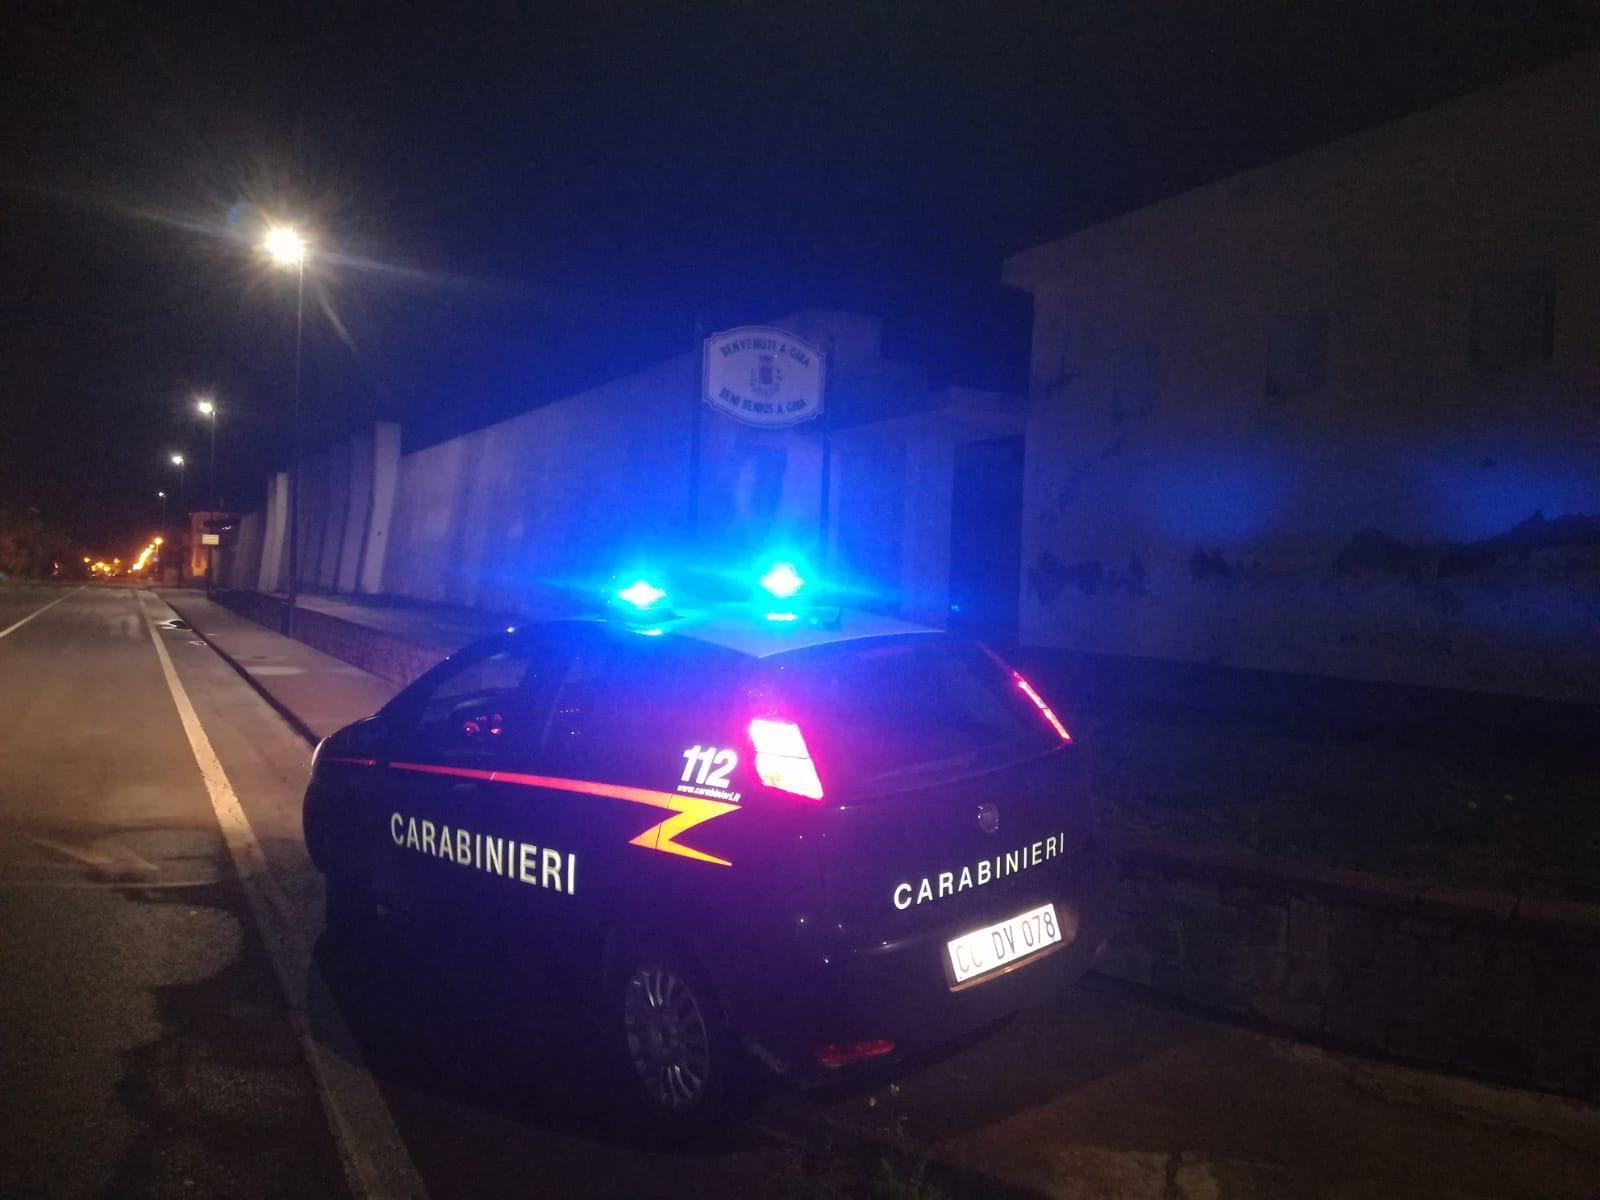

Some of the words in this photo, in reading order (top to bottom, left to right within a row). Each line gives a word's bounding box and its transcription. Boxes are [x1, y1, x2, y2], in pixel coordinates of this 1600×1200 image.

[779, 344, 786, 354] A
[777, 404, 784, 415] A
[681, 745, 738, 788] 112
[391, 812, 576, 895] CARABINIERI
[893, 832, 1064, 910] CARABINIERI
[991, 924, 1017, 960] DV
[1021, 911, 1056, 948] 078
